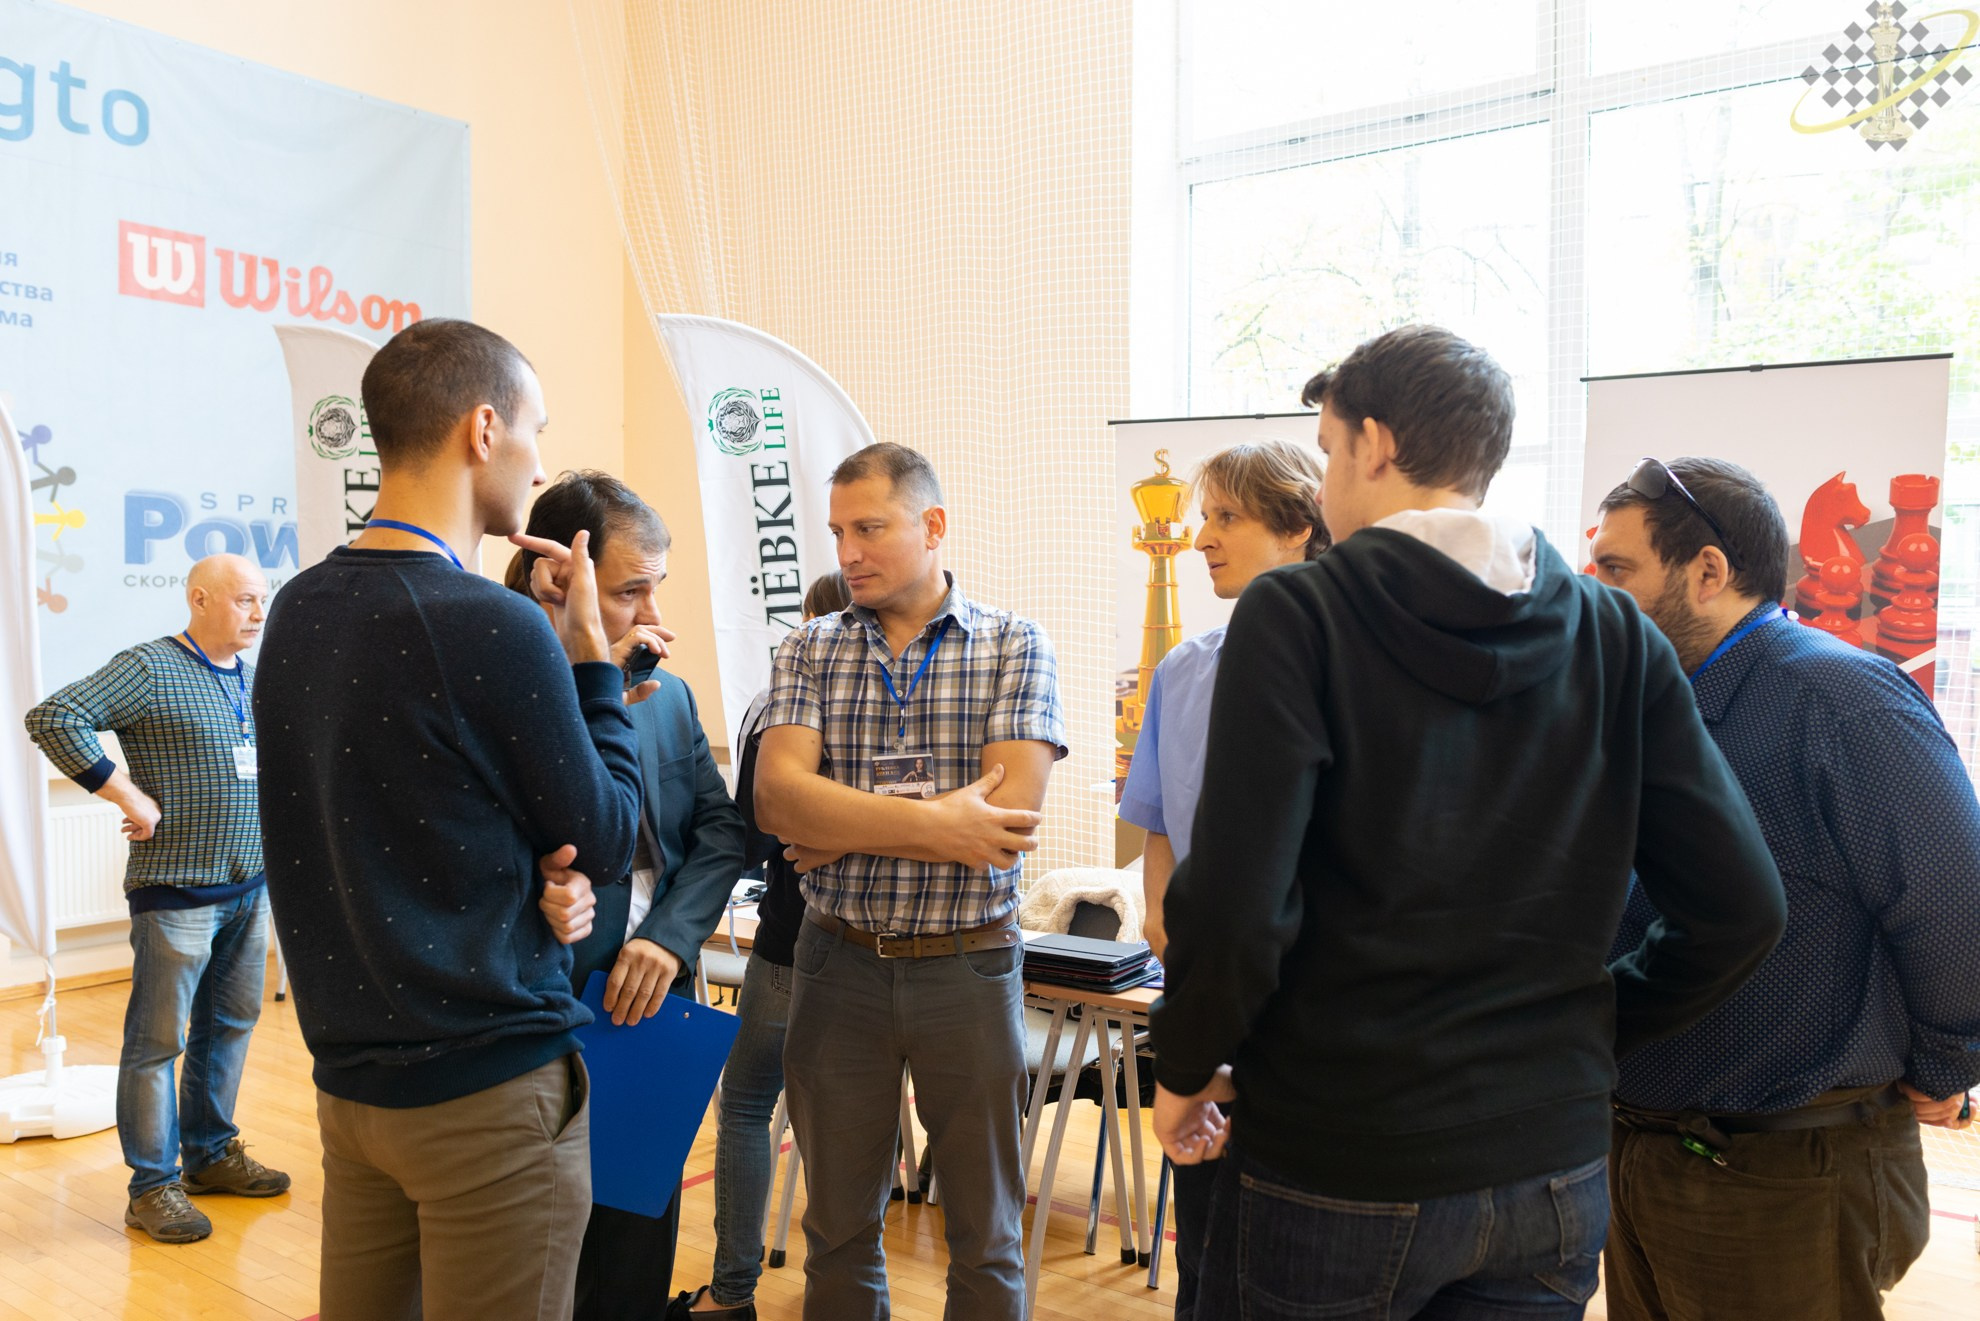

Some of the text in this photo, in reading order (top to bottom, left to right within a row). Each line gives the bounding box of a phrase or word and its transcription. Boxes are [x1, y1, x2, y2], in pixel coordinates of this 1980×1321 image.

[0, 251, 18, 267] я
[214, 247, 423, 333] Wilson
[760, 386, 787, 452] LIFE
[750, 460, 804, 662] ЛЁВКЕ
